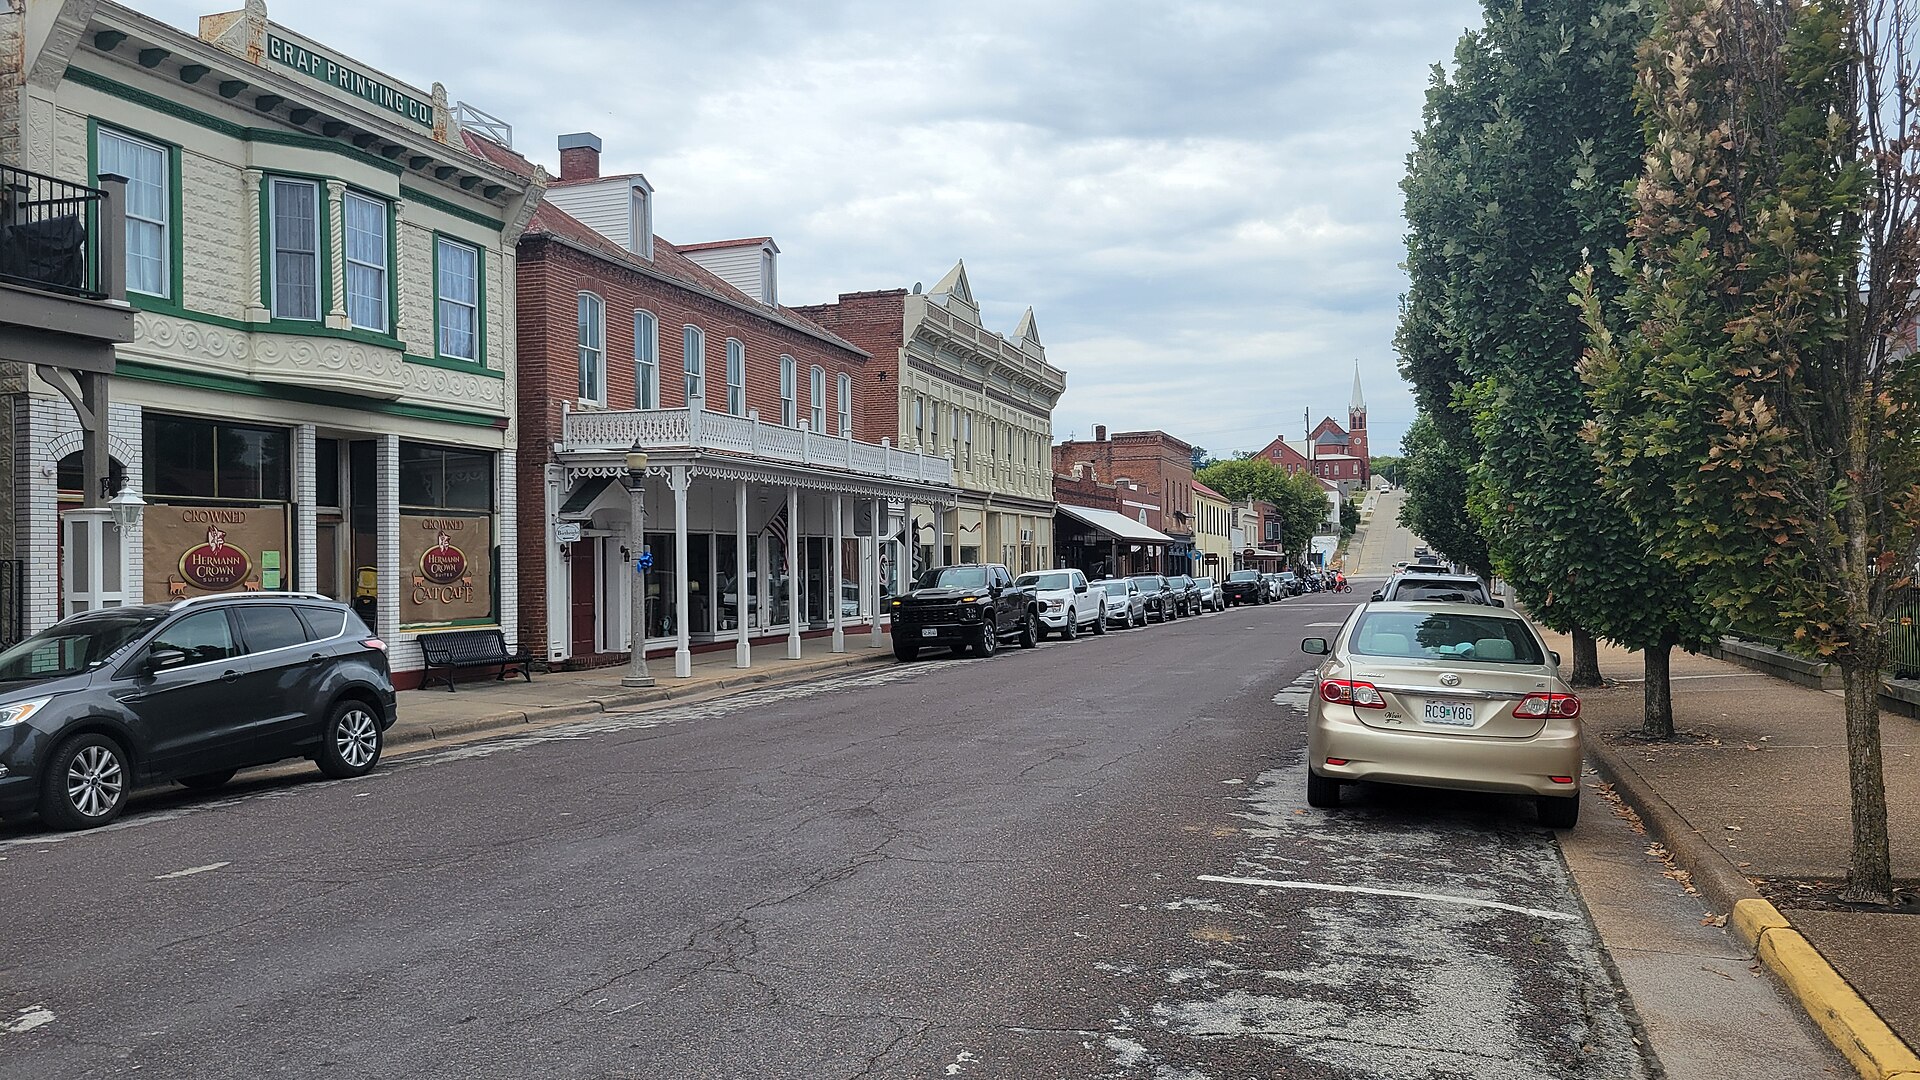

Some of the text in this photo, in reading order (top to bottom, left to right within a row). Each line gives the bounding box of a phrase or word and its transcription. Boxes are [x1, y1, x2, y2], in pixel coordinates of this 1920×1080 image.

[271, 37, 433, 125] GRAF PRINTING CO.
[183, 510, 247, 524] CROWNED
[422, 519, 464, 531] CROWNED
[192, 553, 240, 567] HERMANN
[428, 554, 460, 564] HERMANN
[196, 565, 236, 578] CROWN
[430, 563, 457, 574] CROWN
[413, 586, 440, 605] CAT
[1425, 704, 1473, 721] RC9 Y8G
